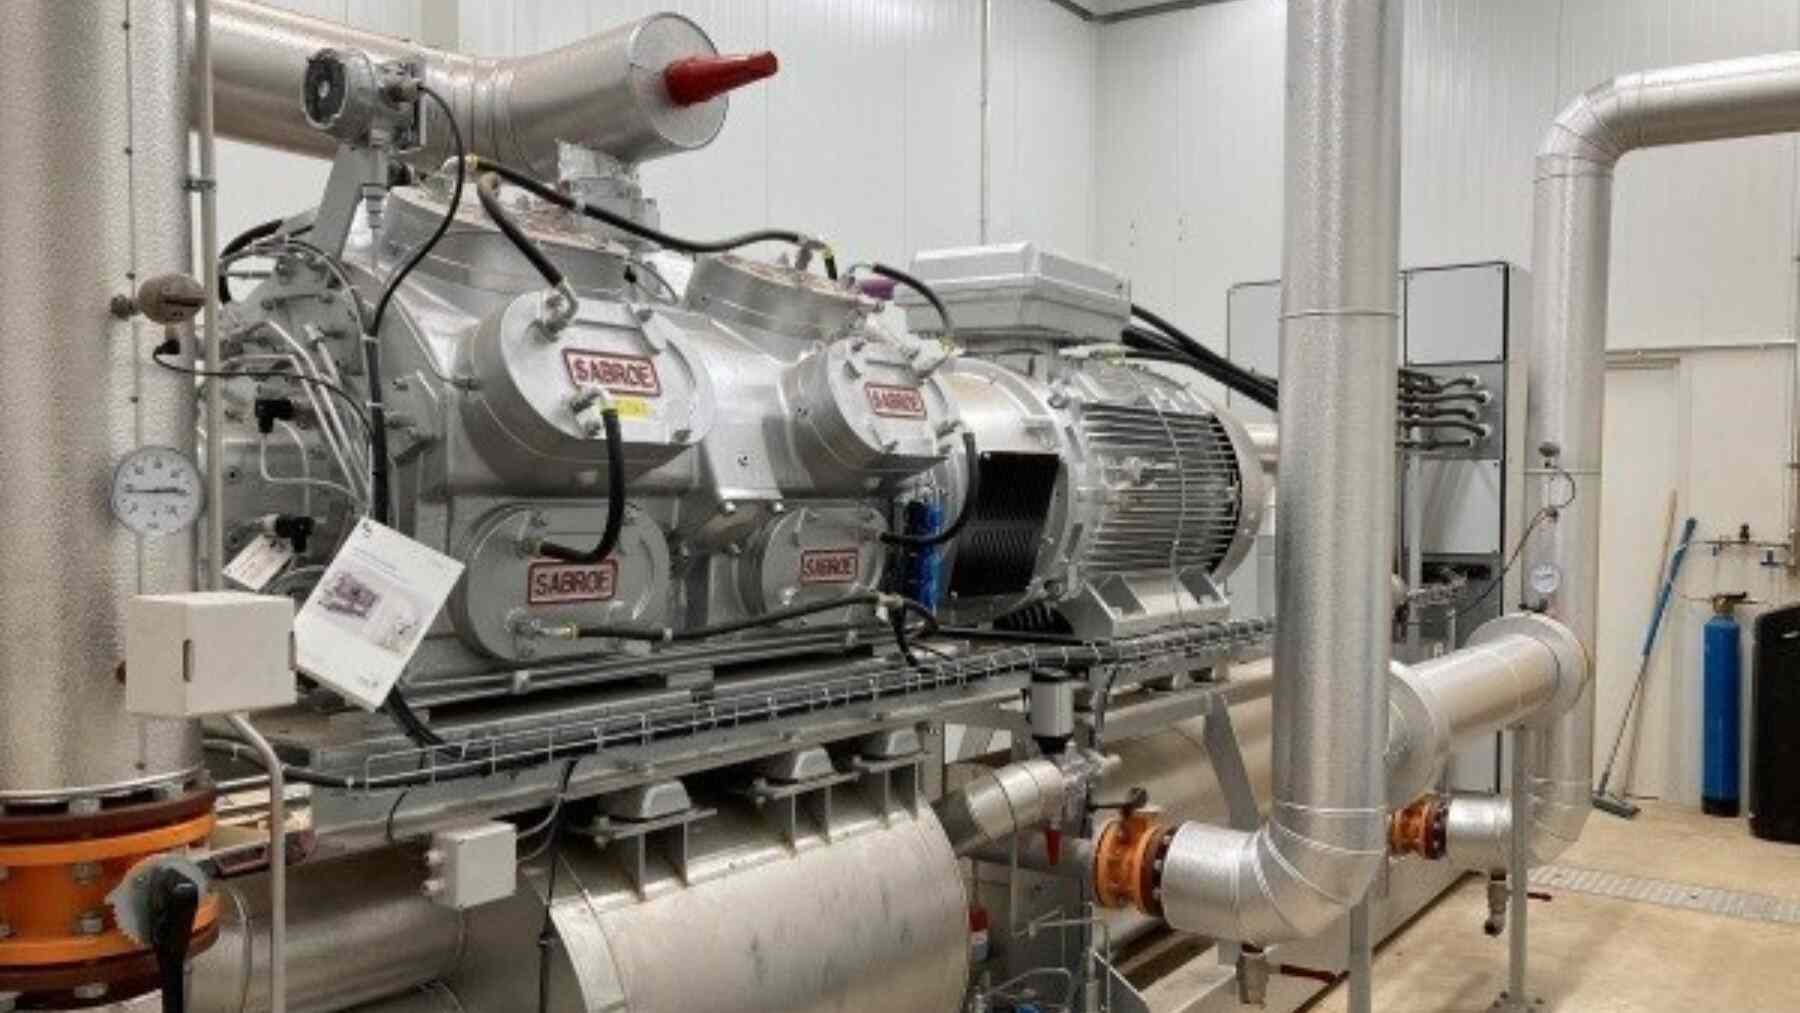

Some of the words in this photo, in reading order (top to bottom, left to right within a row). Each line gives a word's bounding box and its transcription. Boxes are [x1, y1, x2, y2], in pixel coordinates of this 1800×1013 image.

[574, 357, 650, 388] SABROE
[872, 389, 921, 412] SABROE
[804, 556, 856, 576] SABROE
[536, 570, 610, 595] SABROE
